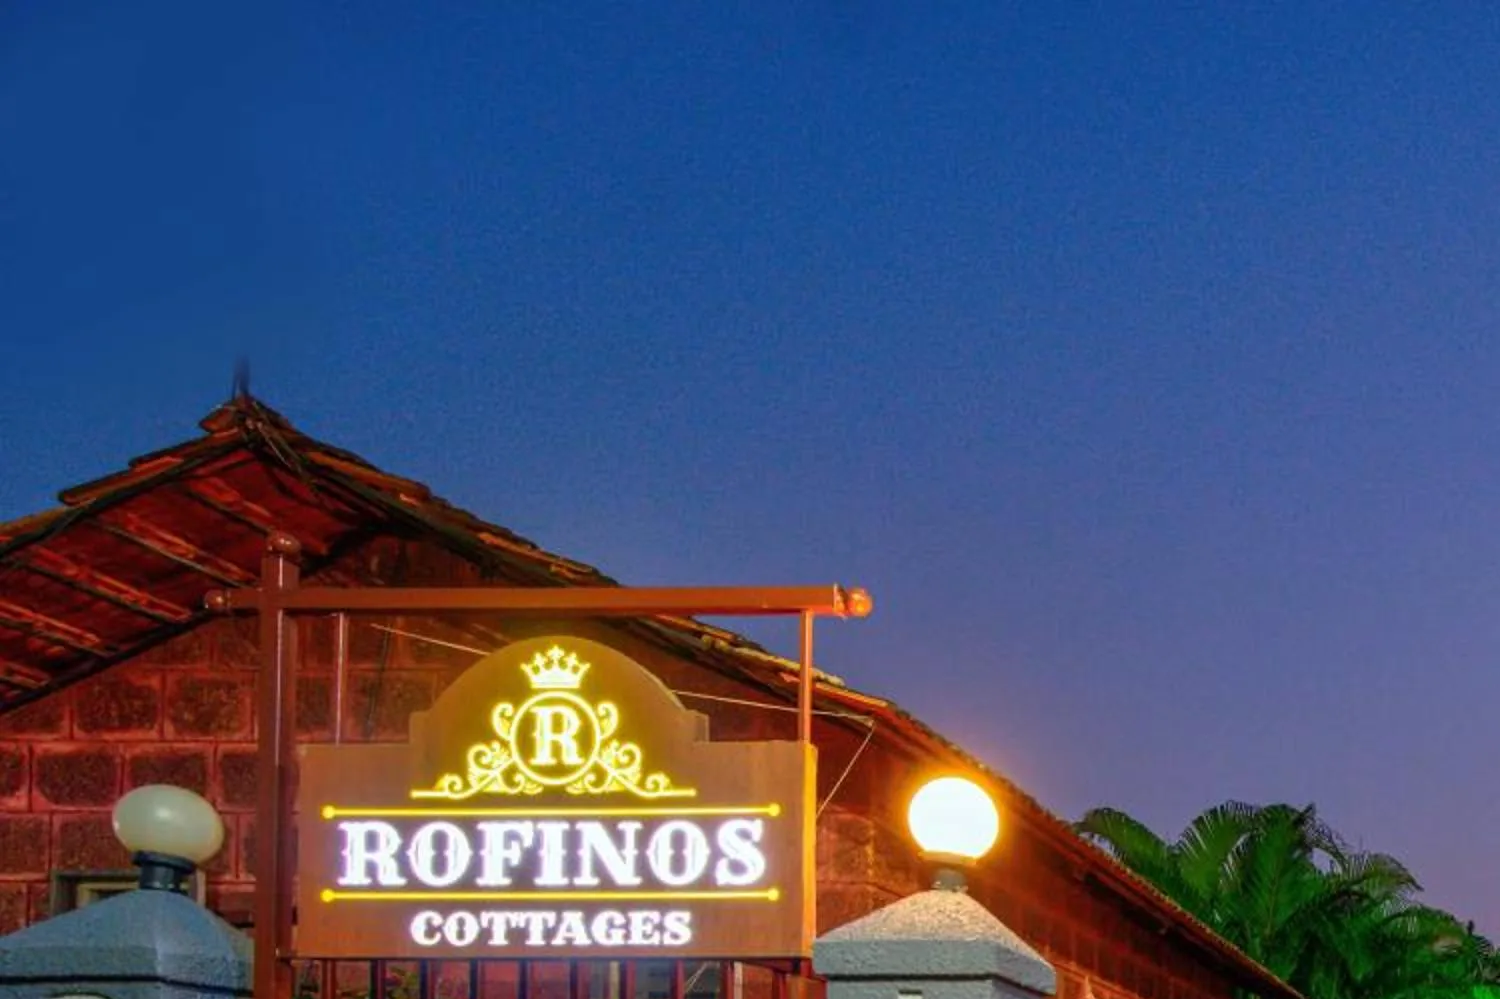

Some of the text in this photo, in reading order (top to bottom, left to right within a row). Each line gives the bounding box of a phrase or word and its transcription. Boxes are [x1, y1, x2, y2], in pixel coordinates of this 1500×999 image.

[530, 705, 583, 766] R
[338, 819, 766, 887] ROFINOS
[410, 910, 692, 946] COTTAGES
